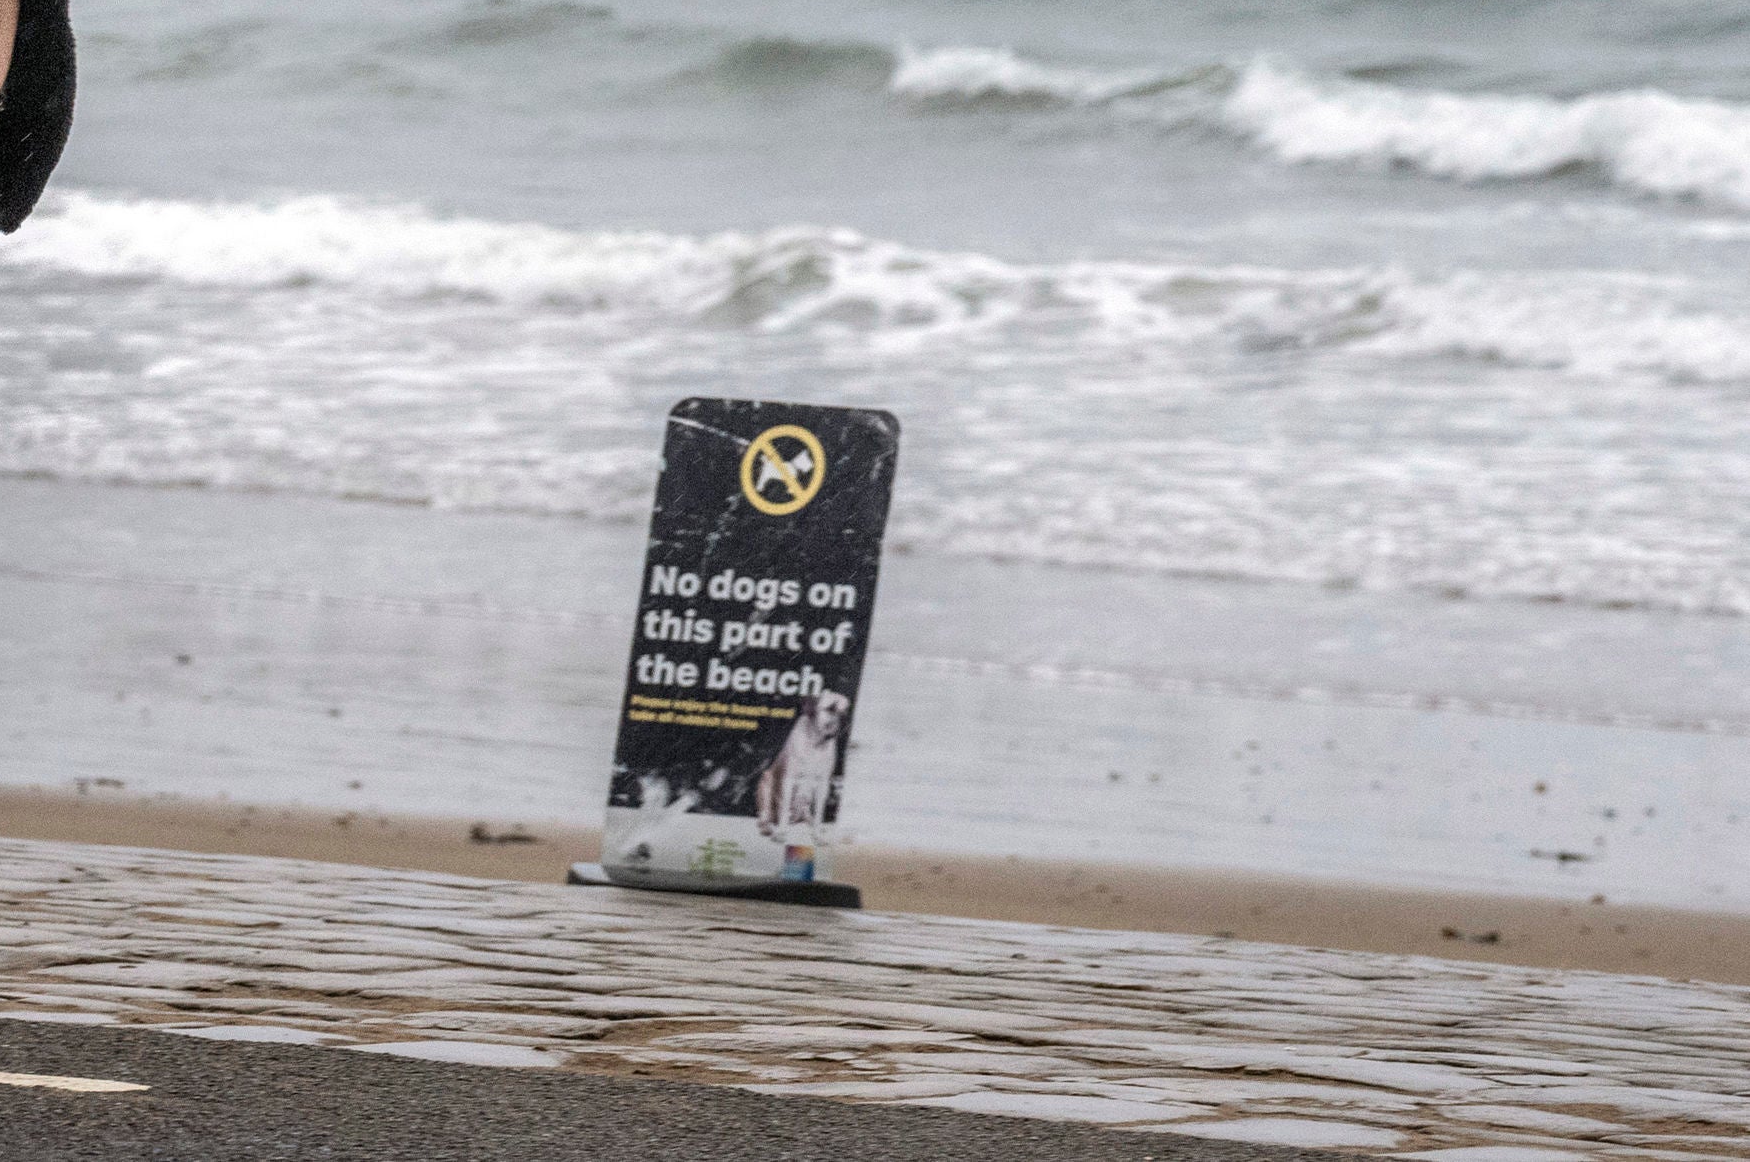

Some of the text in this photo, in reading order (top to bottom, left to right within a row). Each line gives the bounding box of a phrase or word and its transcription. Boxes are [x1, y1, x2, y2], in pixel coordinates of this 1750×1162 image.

[650, 565, 857, 610] No dogs on
[644, 608, 854, 654] this part of
[636, 653, 699, 687] the
